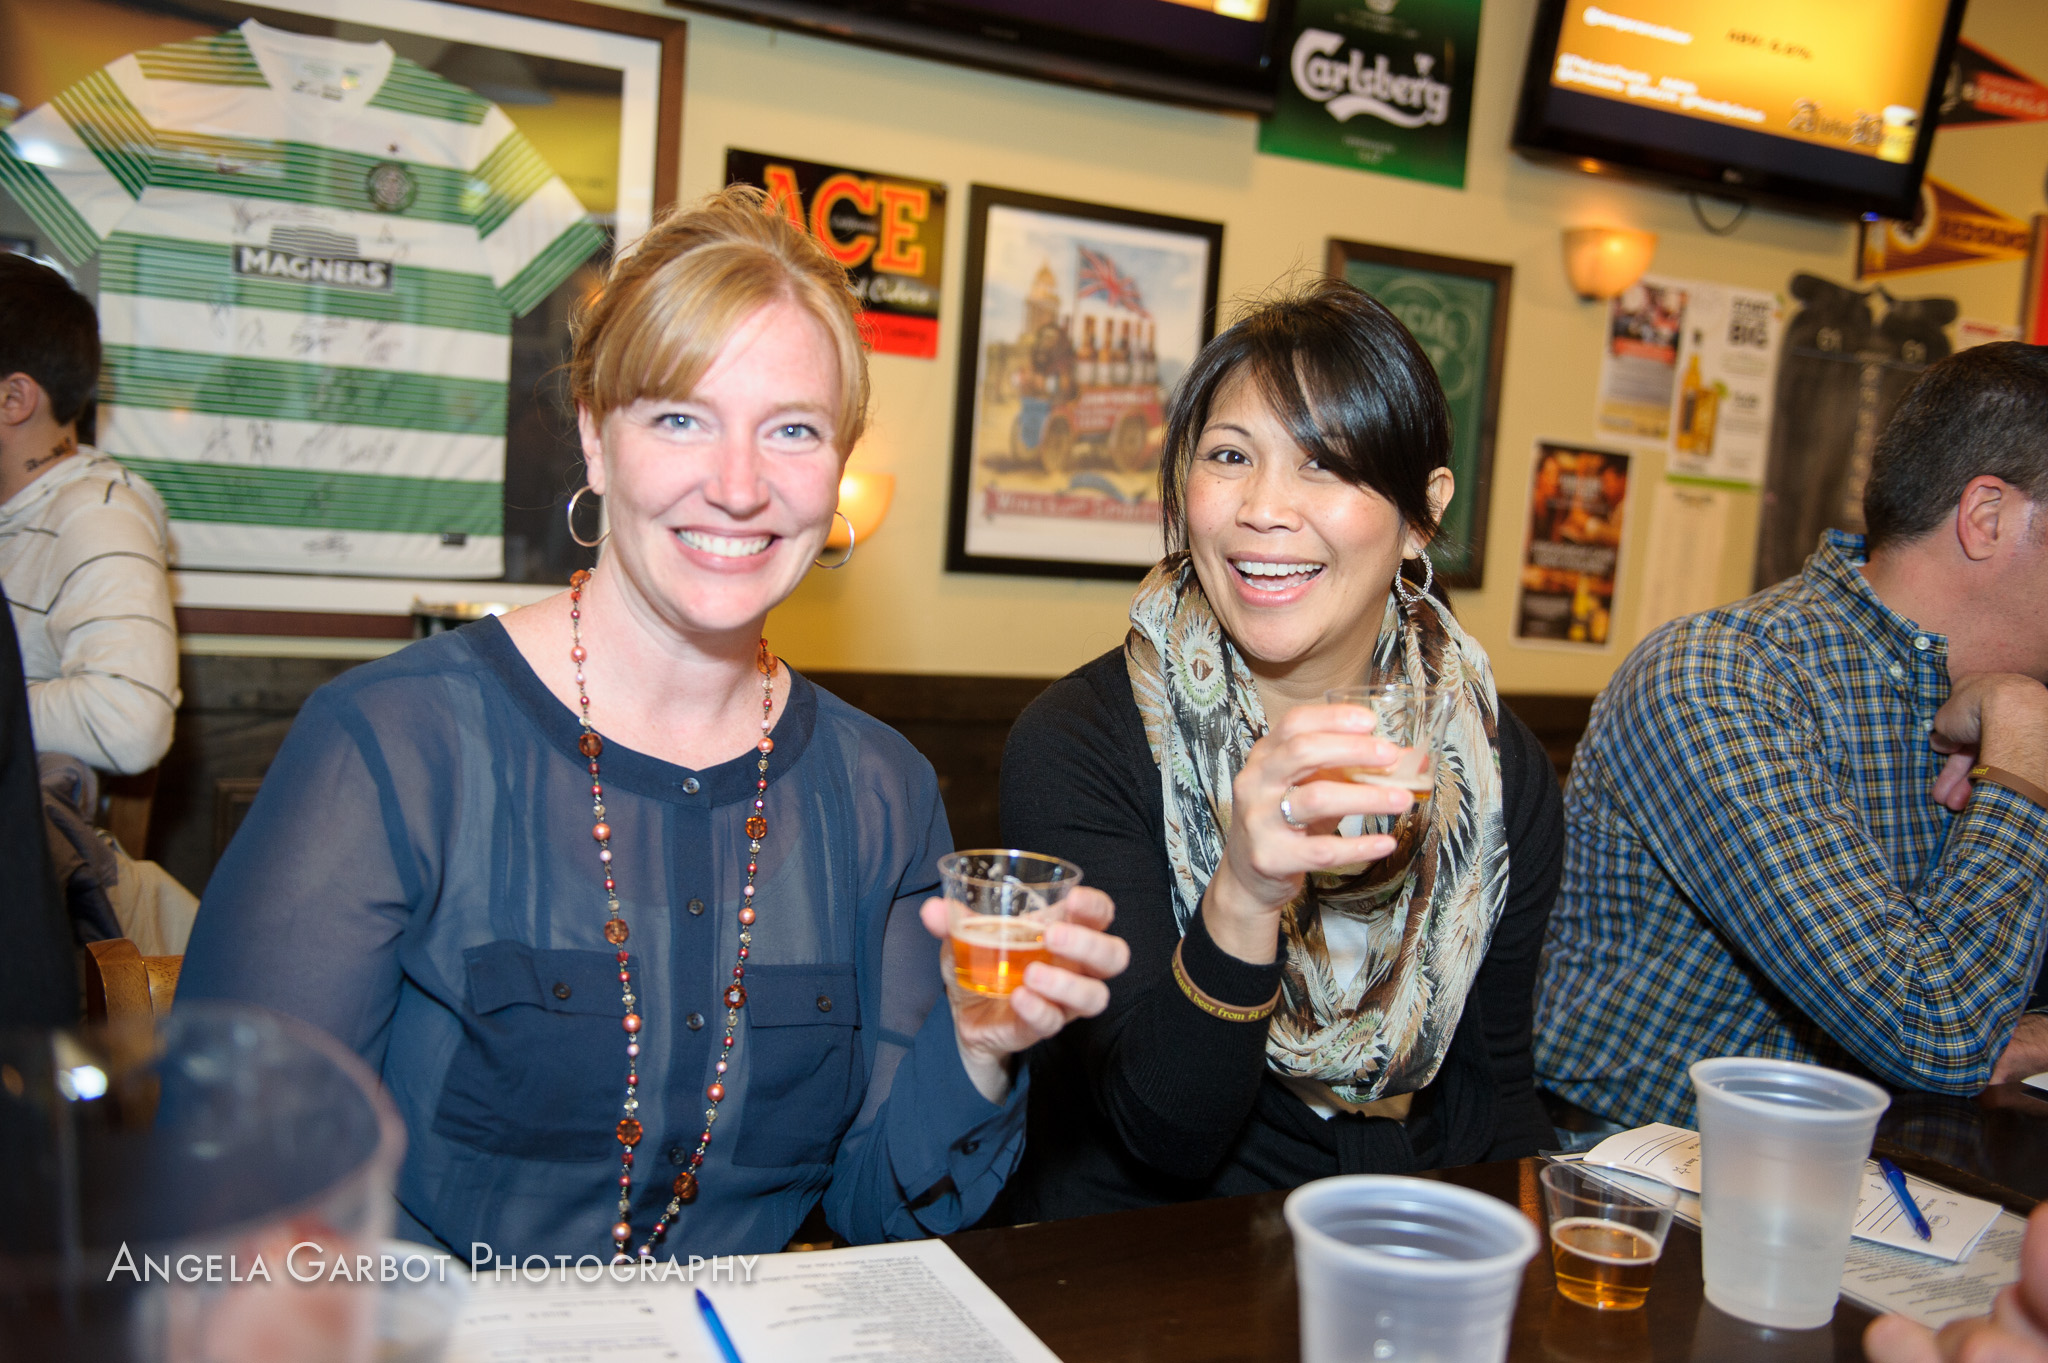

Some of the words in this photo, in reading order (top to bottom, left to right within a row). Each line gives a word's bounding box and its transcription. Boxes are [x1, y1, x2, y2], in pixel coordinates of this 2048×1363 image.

[1291, 28, 1451, 127] Carlsberg
[763, 164, 930, 277] ACE
[241, 249, 387, 288] MAGNERS
[1728, 323, 1768, 348] BIG
[1193, 993, 1215, 1012] beer
[1217, 1007, 1245, 1020] from
